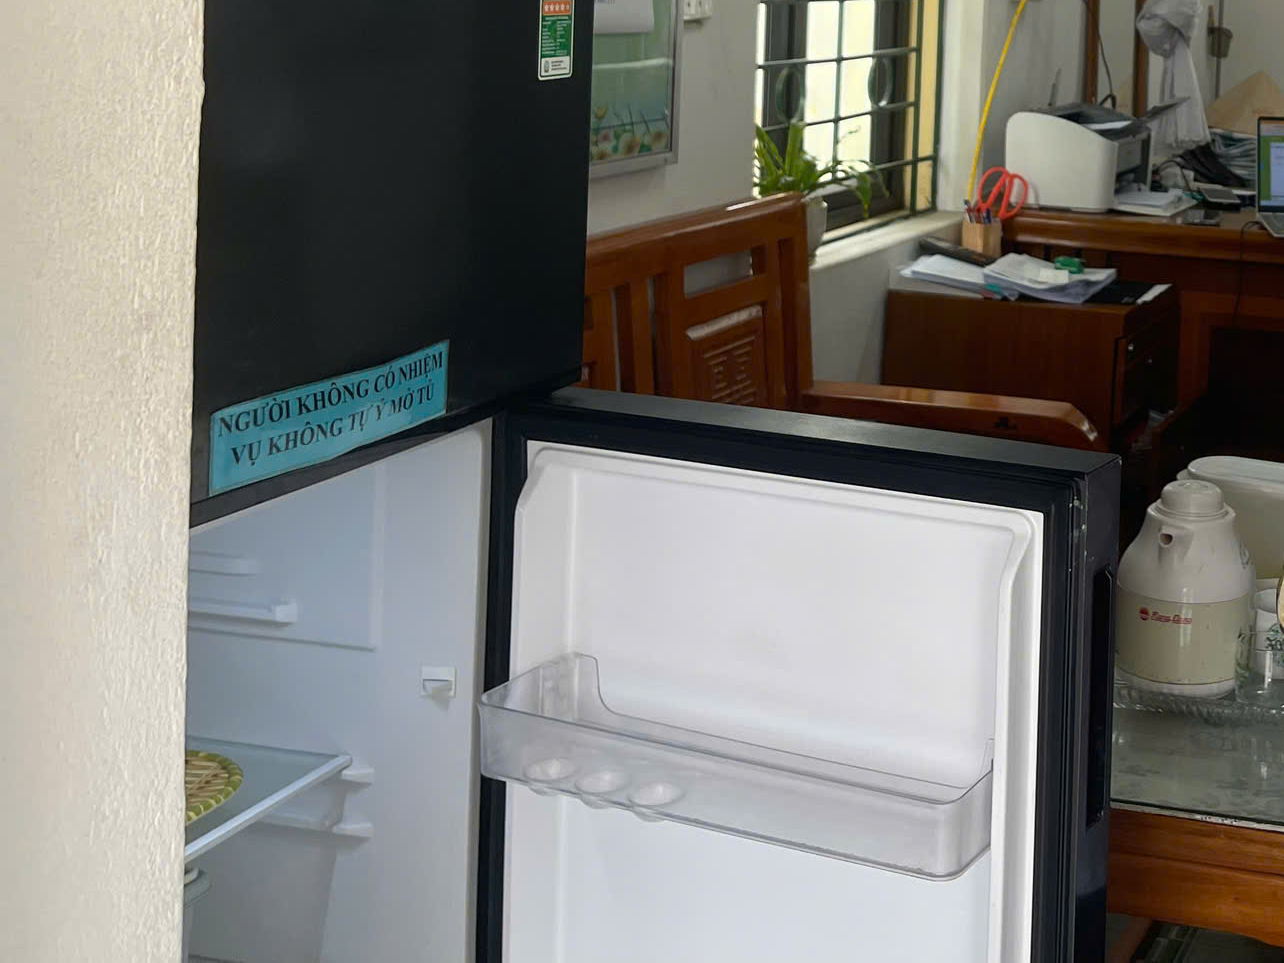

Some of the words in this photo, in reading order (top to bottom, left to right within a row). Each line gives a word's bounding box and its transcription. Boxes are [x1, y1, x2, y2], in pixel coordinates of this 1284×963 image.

[217, 396, 292, 438] NGƯỜI
[297, 379, 370, 417] KHÔNG
[374, 364, 396, 394] CÓ
[398, 351, 444, 382] NHIỆM
[230, 440, 263, 467] VỤ
[267, 417, 343, 457] KHÔNG
[348, 405, 374, 433] TỰ
[375, 397, 388, 422] Ý
[389, 390, 415, 417] MỞ
[416, 378, 434, 405] TỦ
